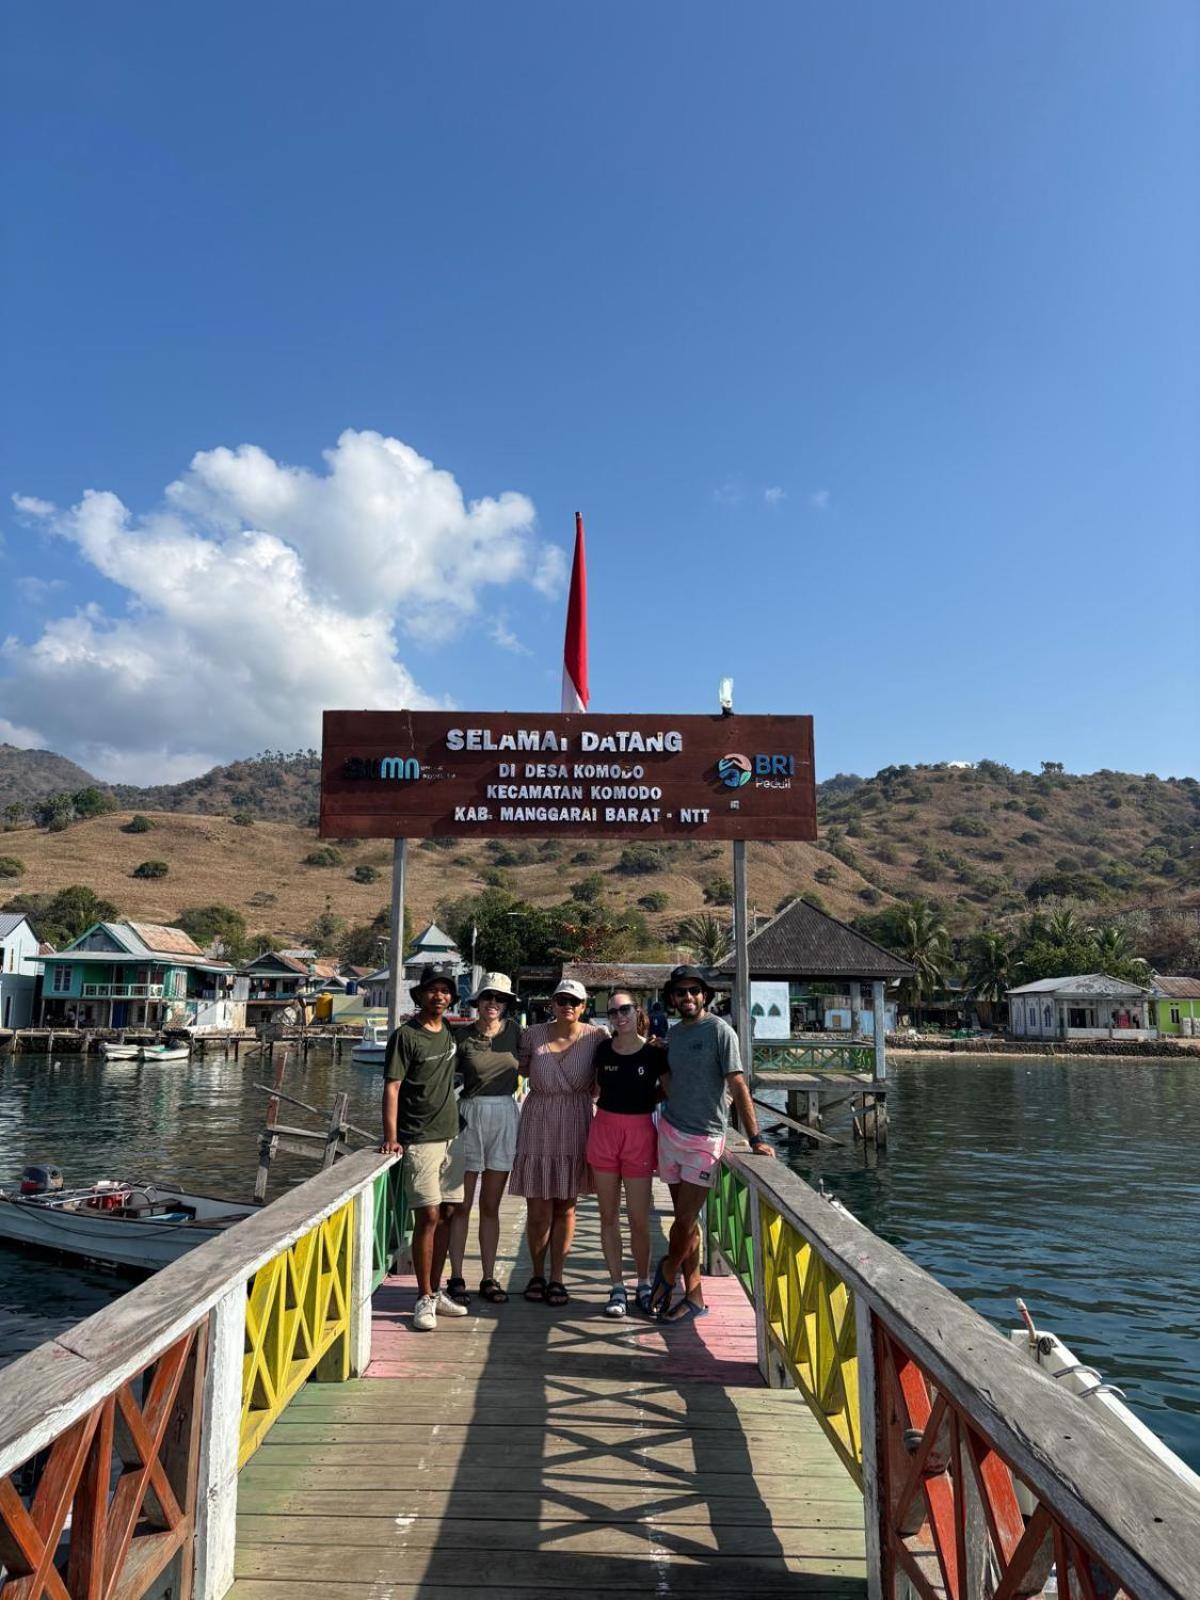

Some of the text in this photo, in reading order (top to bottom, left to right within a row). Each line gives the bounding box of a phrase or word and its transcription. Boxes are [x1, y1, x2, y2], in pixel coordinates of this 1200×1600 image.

[581, 731, 683, 752] DATANG
[499, 763, 516, 778] DI
[525, 764, 568, 779] DESA
[755, 754, 795, 776] BRI
[486, 785, 662, 800] KECAMATAN KOMODO
[500, 807, 597, 822] MANGGARAI
[605, 808, 660, 822] BARAT
[680, 808, 710, 823] NTT
